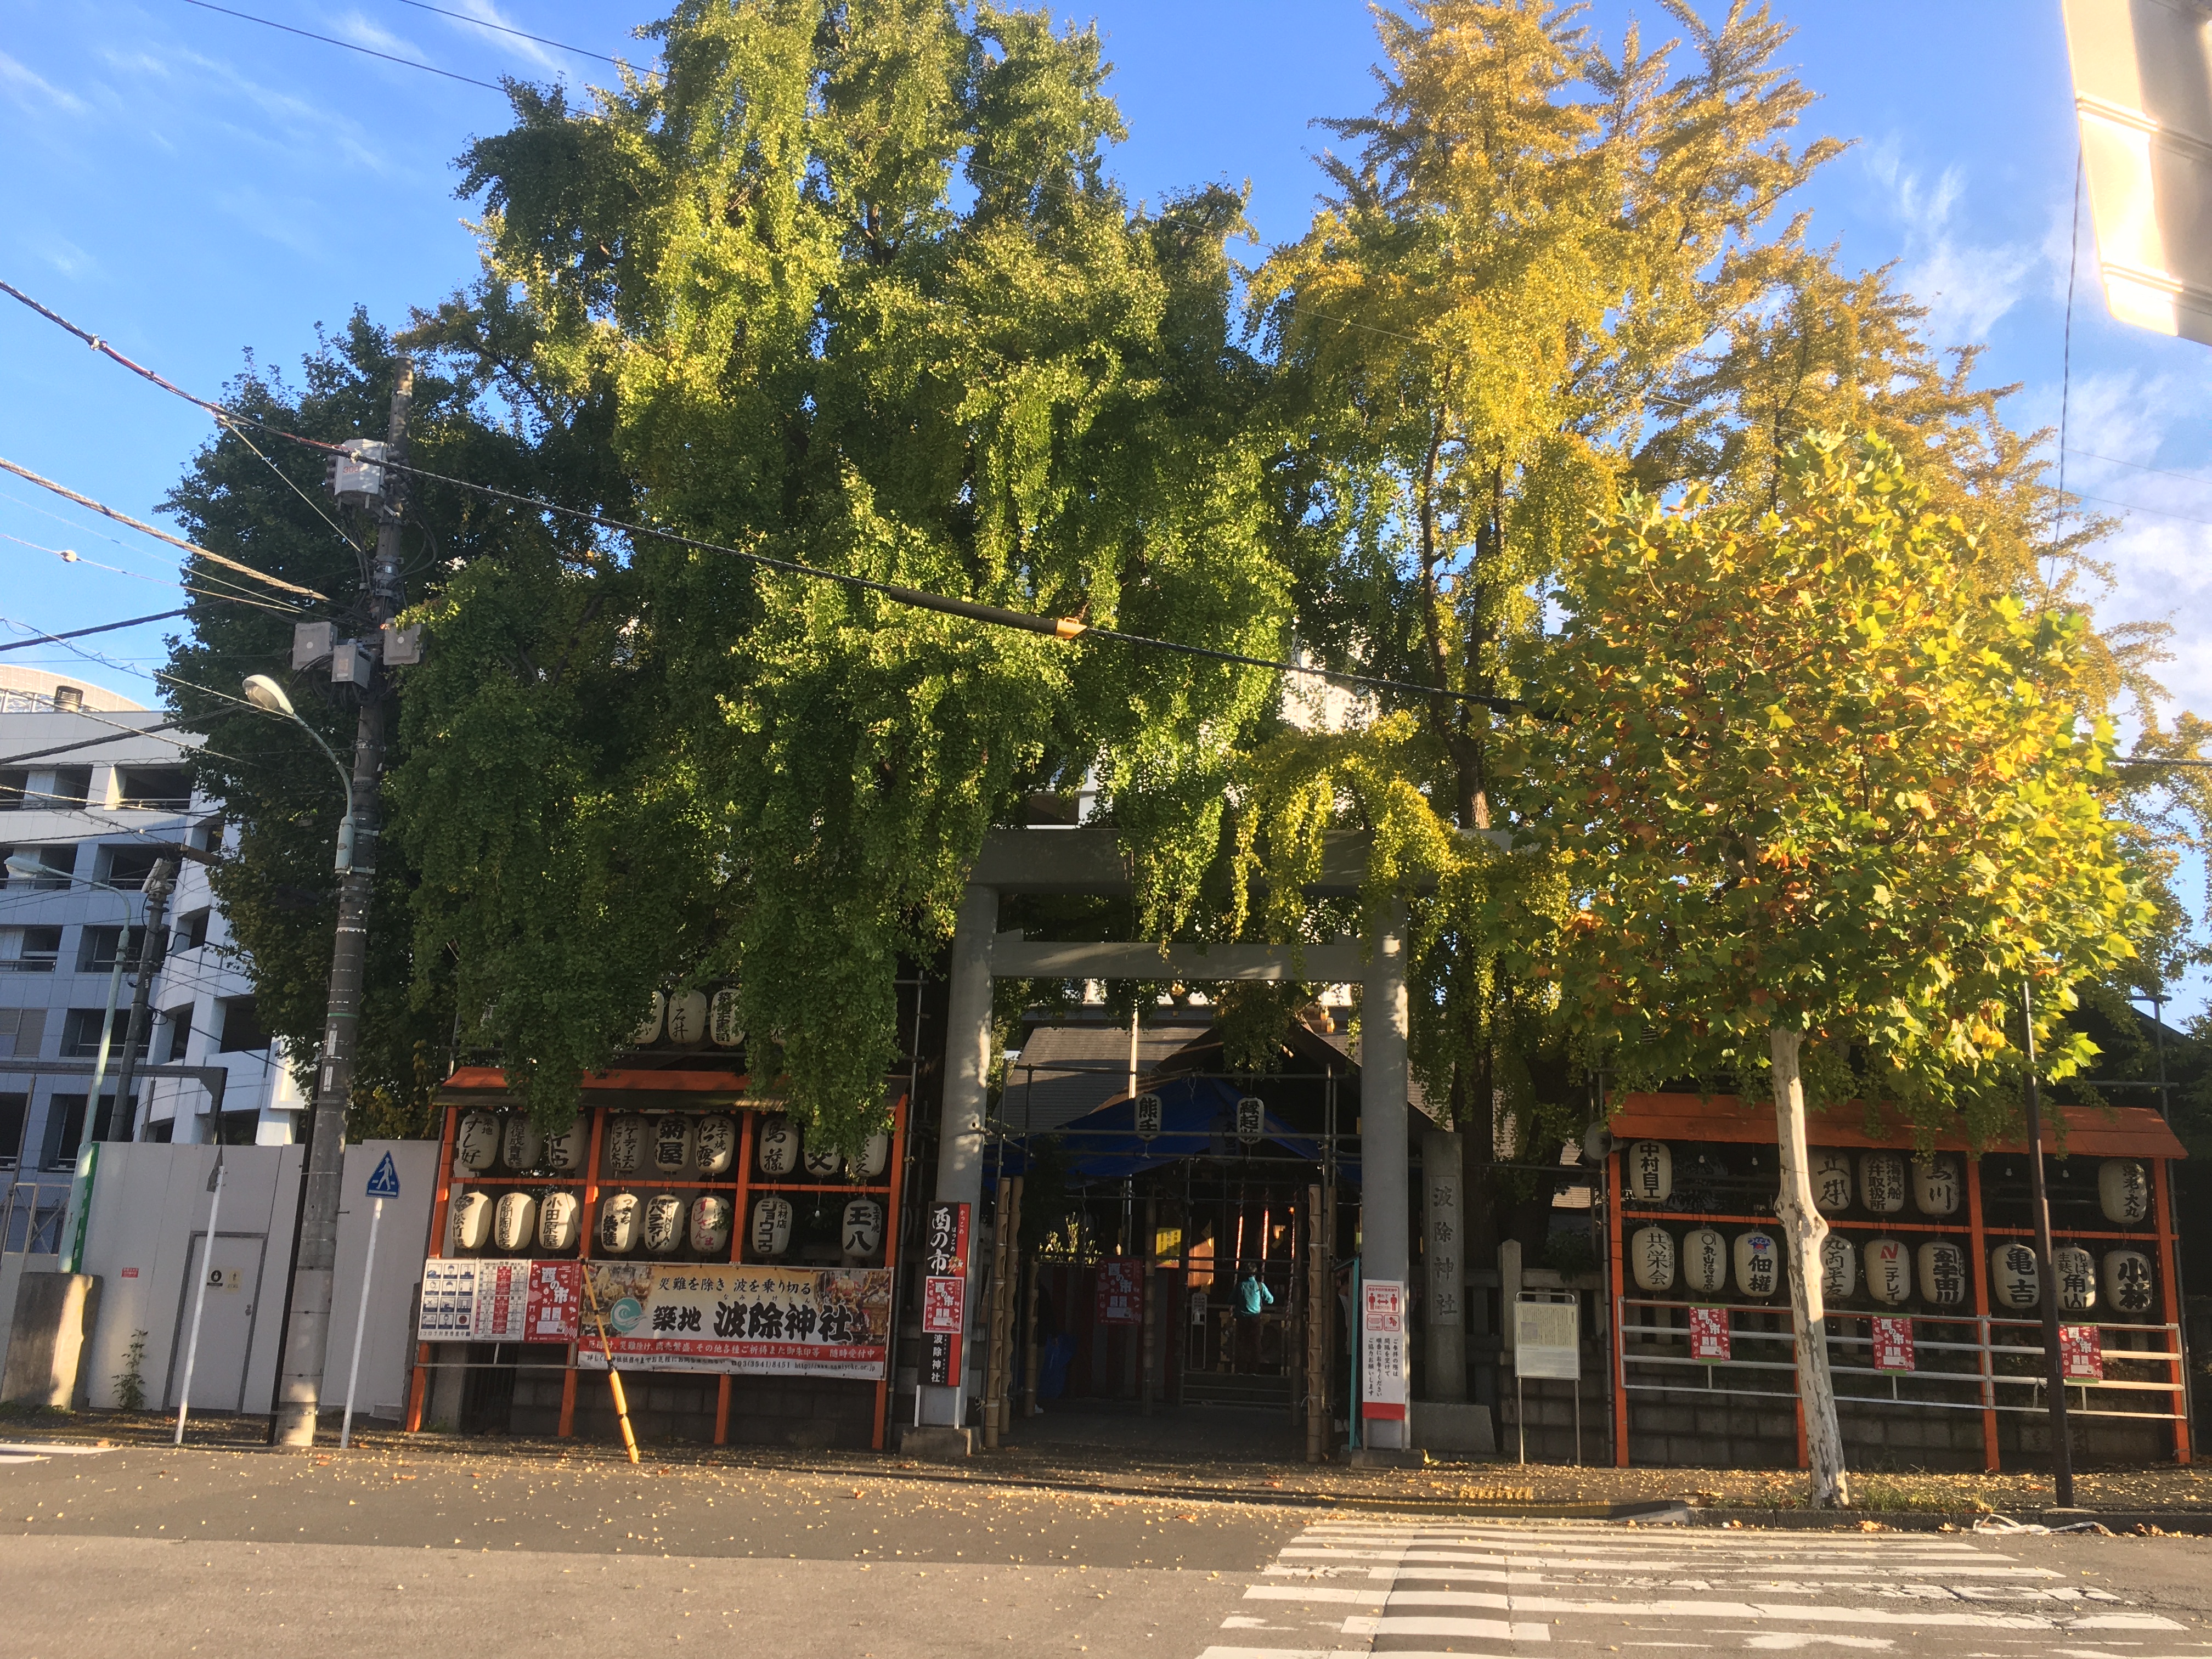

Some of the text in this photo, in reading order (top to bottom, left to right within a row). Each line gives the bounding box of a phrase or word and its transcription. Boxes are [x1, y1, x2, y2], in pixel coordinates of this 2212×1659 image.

[342, 466, 359, 474] 300
[461, 1118, 482, 1164] すし好
[659, 1119, 686, 1165] 菊屋
[1639, 1142, 1661, 1199] 中村自工
[543, 1197, 562, 1248] 小田原屋
[845, 1206, 873, 1251] 玉八
[927, 1207, 951, 1276] 酉の市
[1433, 1186, 1457, 1316] 波除神社
[1646, 1232, 1669, 1285] 共栄会
[658, 1277, 811, 1295] 災難を除き 波を乗り切る
[1884, 1260, 1901, 1301] ニチレイ
[2006, 1248, 2036, 1304] 亀吉
[2063, 1273, 2087, 1309] 角山
[2118, 1257, 2153, 1310] 小林
[652, 1300, 854, 1344] 築地 波除神社
[830, 1348, 875, 1359] 随時受付中
[932, 1334, 943, 1383] 波除神社
